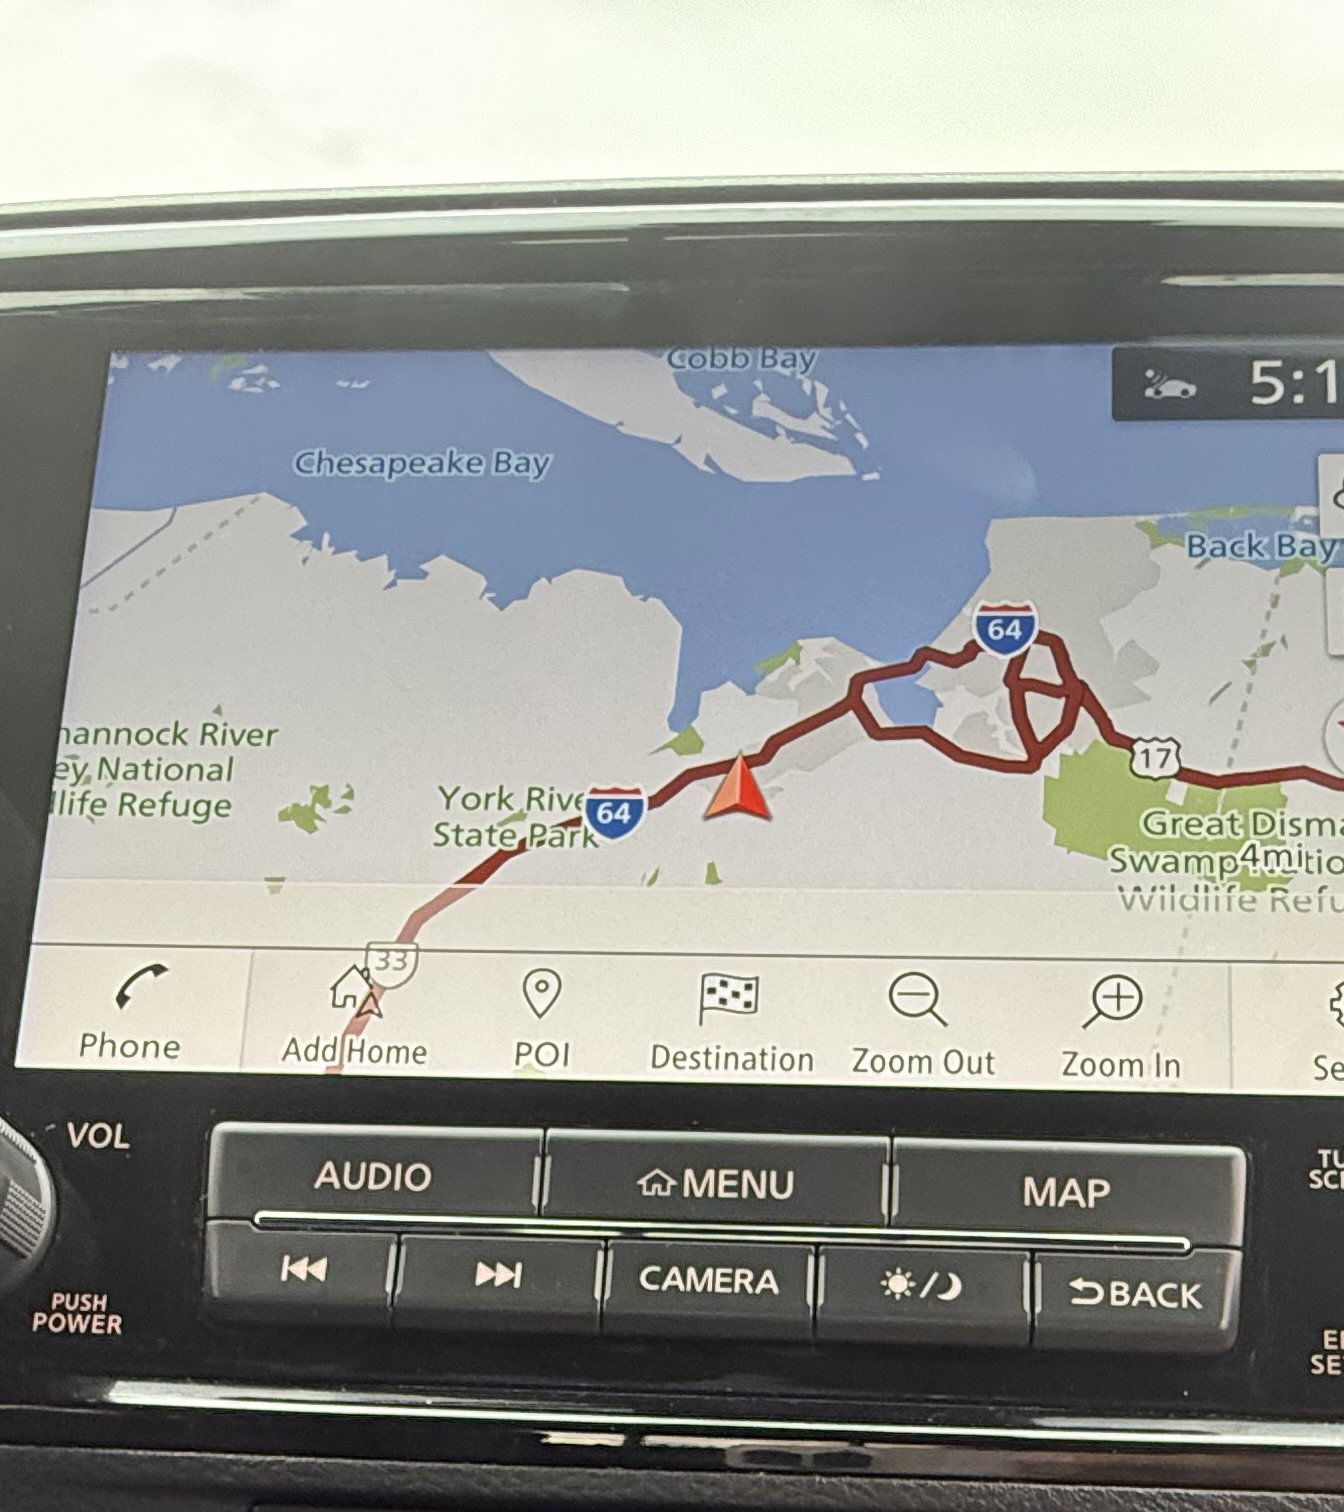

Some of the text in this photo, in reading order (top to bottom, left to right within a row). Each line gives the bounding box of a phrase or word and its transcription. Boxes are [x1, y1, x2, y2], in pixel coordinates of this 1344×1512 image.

[667, 344, 816, 375] Cobb Bay
[294, 449, 551, 480] Chesapeake Bay
[1187, 533, 1339, 564] Back Bay
[987, 618, 1023, 642] 64
[199, 722, 280, 748] River
[98, 755, 234, 782] National
[1139, 746, 1173, 770] 17
[118, 790, 233, 825] Refuge
[437, 785, 586, 812] York Rive
[596, 801, 632, 826] 64
[1142, 810, 1241, 837] Great
[433, 821, 601, 849] State Park
[1110, 846, 1239, 880] Swamp
[1118, 883, 1258, 912] Wildlife
[374, 950, 409, 972] 33
[80, 1032, 181, 1060] Phone
[282, 1035, 428, 1066] Add Home
[515, 1041, 571, 1068] POI
[651, 1043, 815, 1074] Destination
[852, 1047, 997, 1077] Zoom Out
[1062, 1050, 1182, 1079] Zoom In
[66, 1121, 131, 1151] VOL
[313, 1160, 434, 1194] AUDIO
[683, 1168, 795, 1201] MENU
[1022, 1175, 1112, 1210] MAP
[638, 1265, 781, 1296] CAMERA
[50, 1291, 109, 1312] PUSH
[1108, 1281, 1204, 1311] BACK
[31, 1311, 124, 1336] POWER
